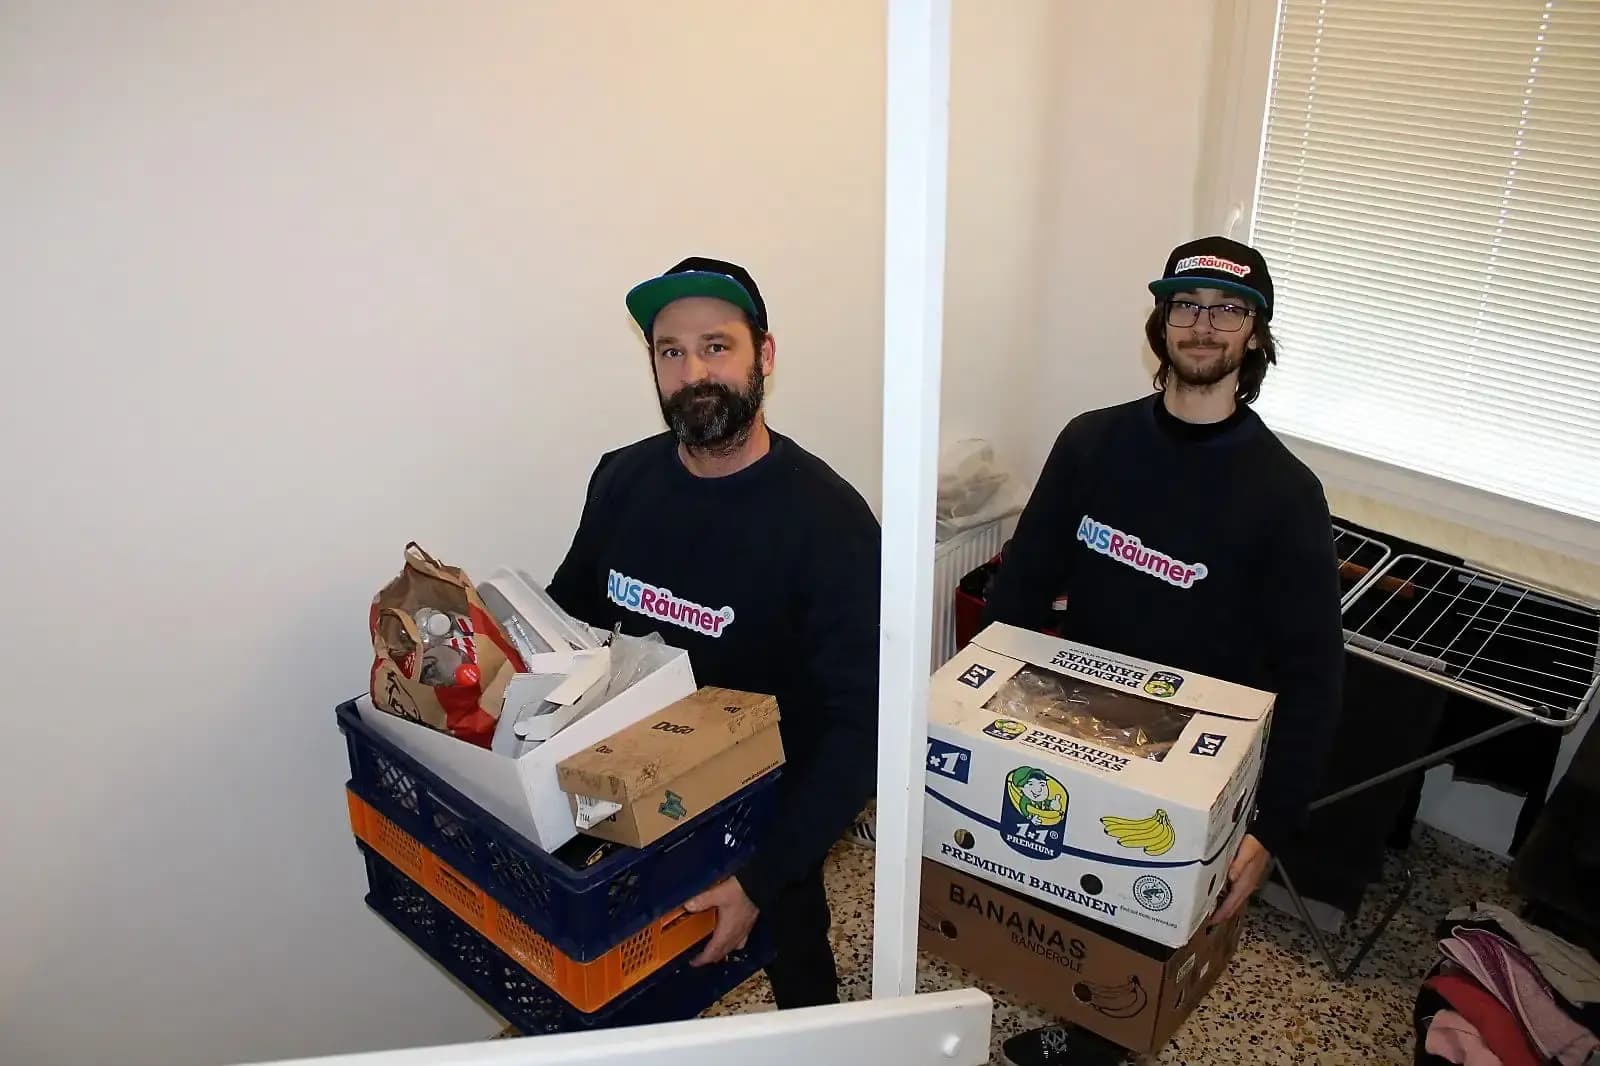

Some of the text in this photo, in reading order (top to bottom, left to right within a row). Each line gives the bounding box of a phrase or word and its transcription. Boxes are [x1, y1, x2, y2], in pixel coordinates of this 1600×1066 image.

[1049, 657, 1141, 689] PREMIUM
[1056, 650, 1148, 681] BANANAS
[1023, 736, 1125, 772] BANANAS
[1031, 730, 1131, 766] PREMIUM
[1006, 834, 1055, 857] PREMIUM
[941, 843, 1026, 885] PREMIUM
[1028, 875, 1118, 917] BANANEN
[949, 883, 1088, 961] BANANAS
